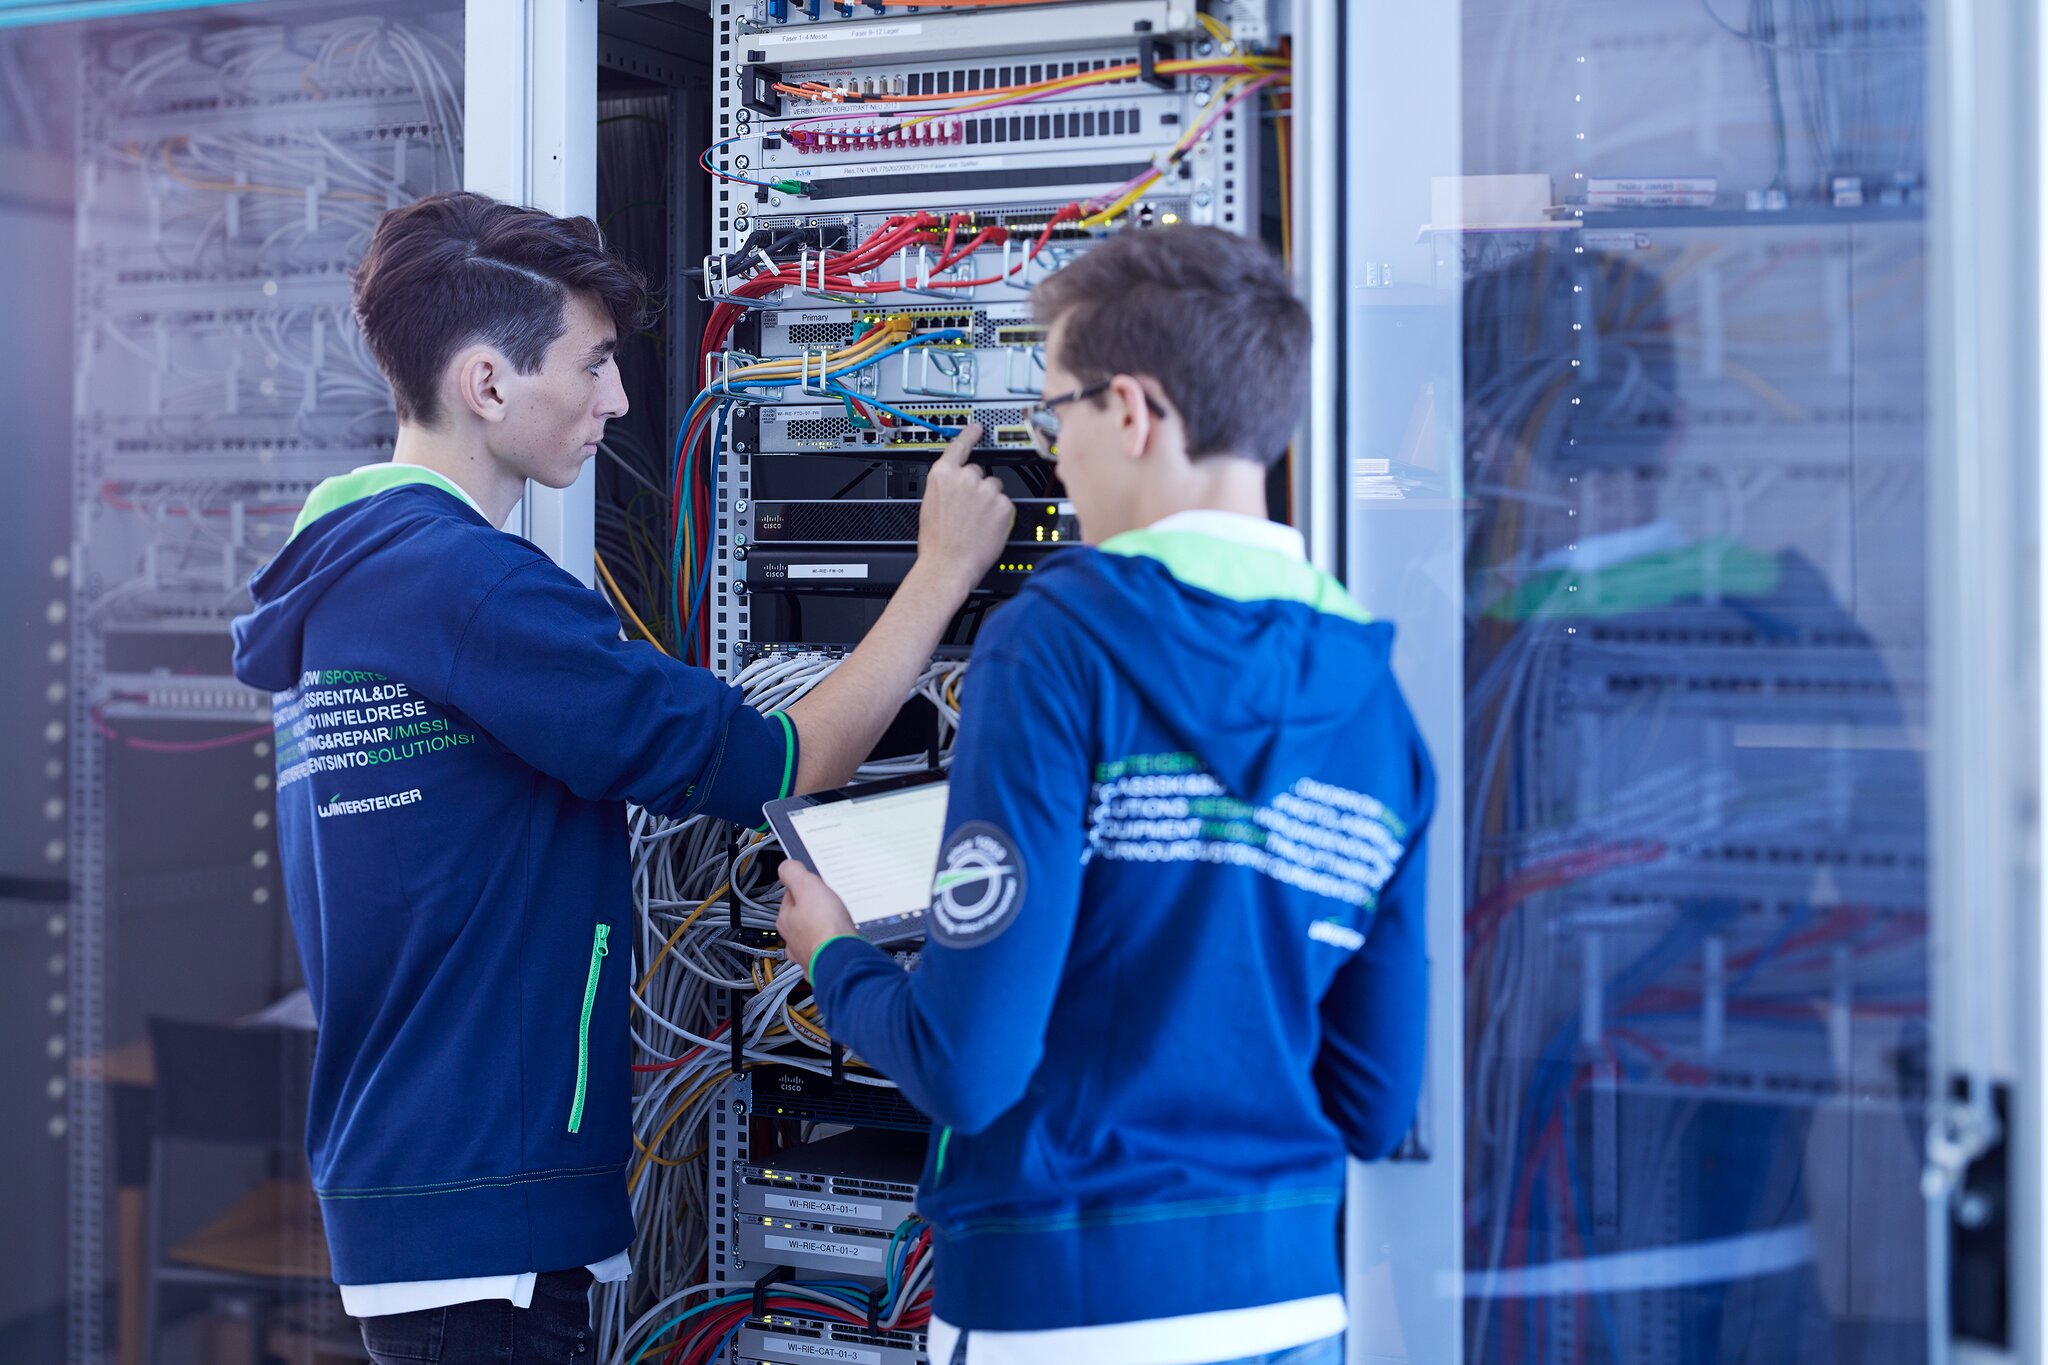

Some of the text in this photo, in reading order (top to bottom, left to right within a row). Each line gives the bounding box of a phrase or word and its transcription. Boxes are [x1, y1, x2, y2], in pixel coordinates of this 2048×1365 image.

[793, 106, 832, 115] VERBINDUNG
[801, 313, 829, 322] Primary
[317, 788, 422, 818] WINTERSTEIGER
[780, 1083, 802, 1092] CISCO
[788, 1199, 858, 1215] WI-RIE-CAT-01-1
[788, 1239, 859, 1256] WI-RIE-CAT-01-2
[787, 1342, 858, 1360] WI-RIE-CAT-01-3
